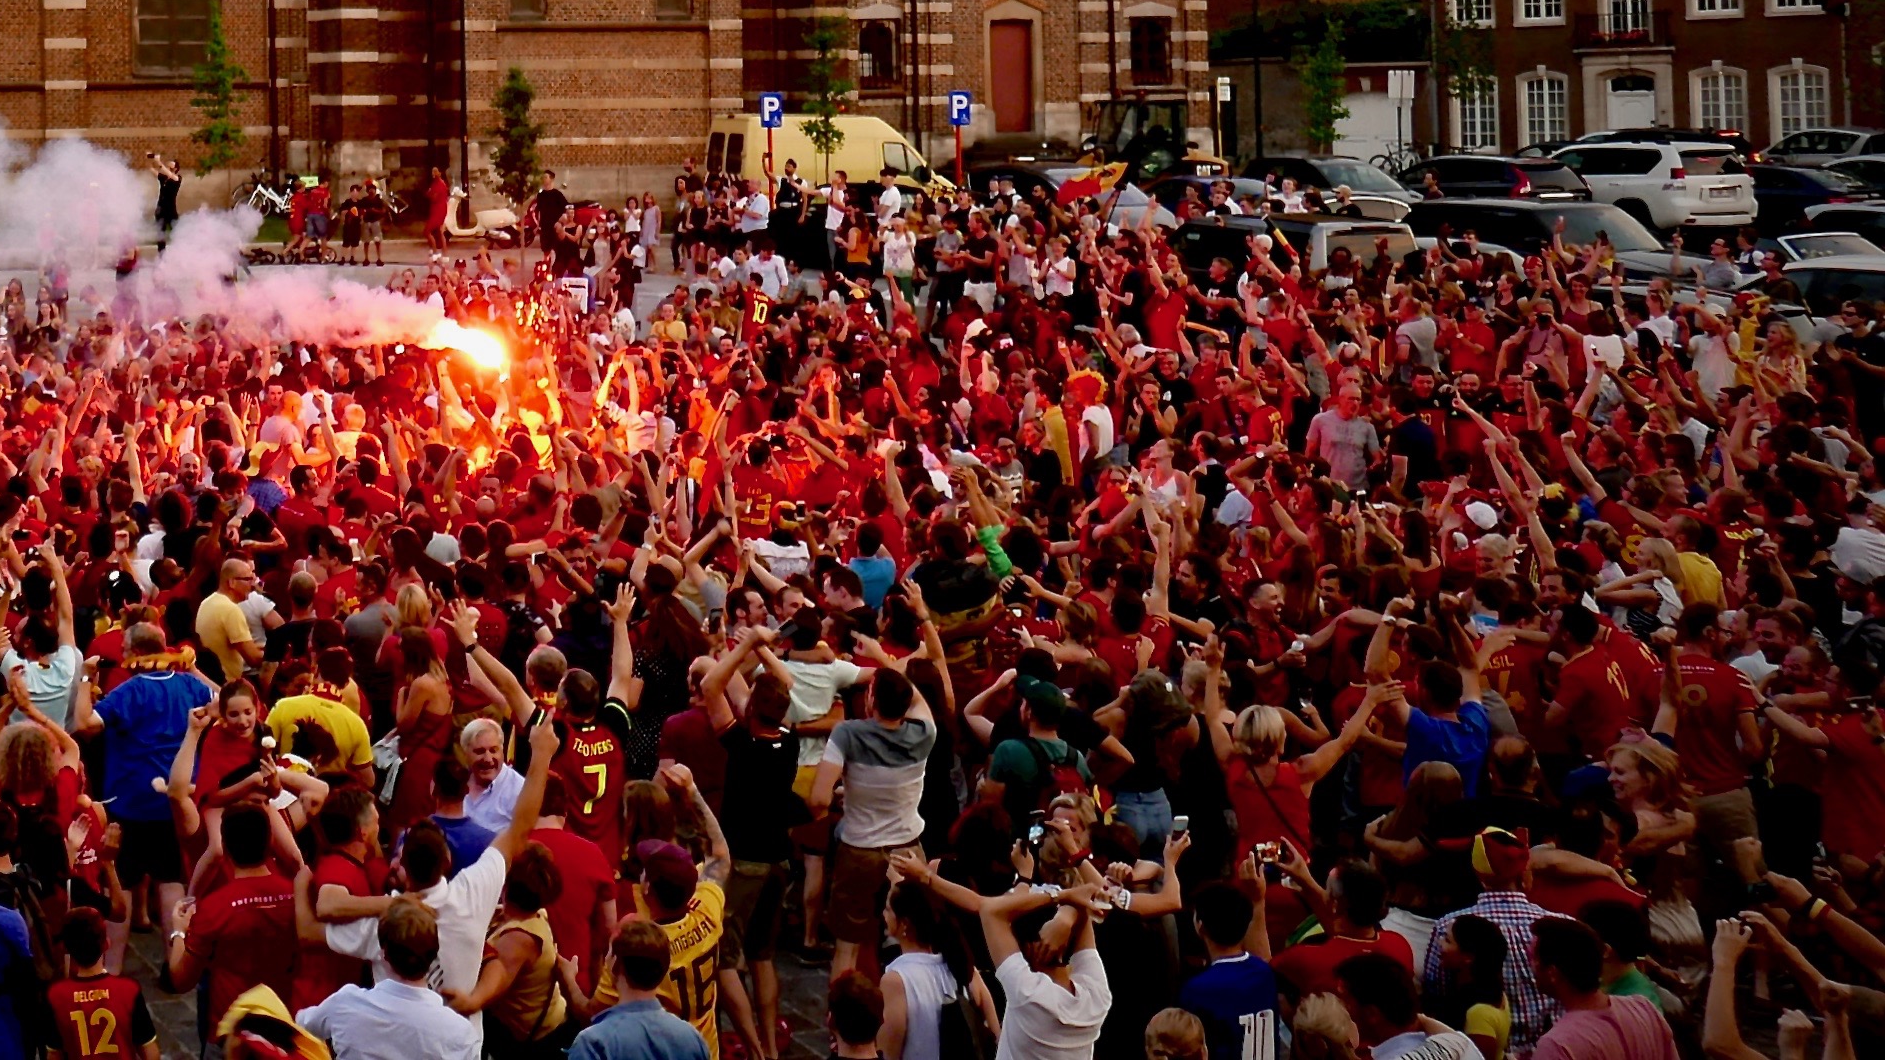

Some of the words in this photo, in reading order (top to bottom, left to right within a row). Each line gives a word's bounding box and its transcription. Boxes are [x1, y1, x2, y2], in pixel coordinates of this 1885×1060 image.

[763, 97, 780, 122] P
[952, 95, 968, 119] P
[752, 300, 769, 325] 10
[583, 763, 607, 814] 7
[73, 989, 110, 1003] BELGIUM
[69, 1007, 119, 1056] 12
